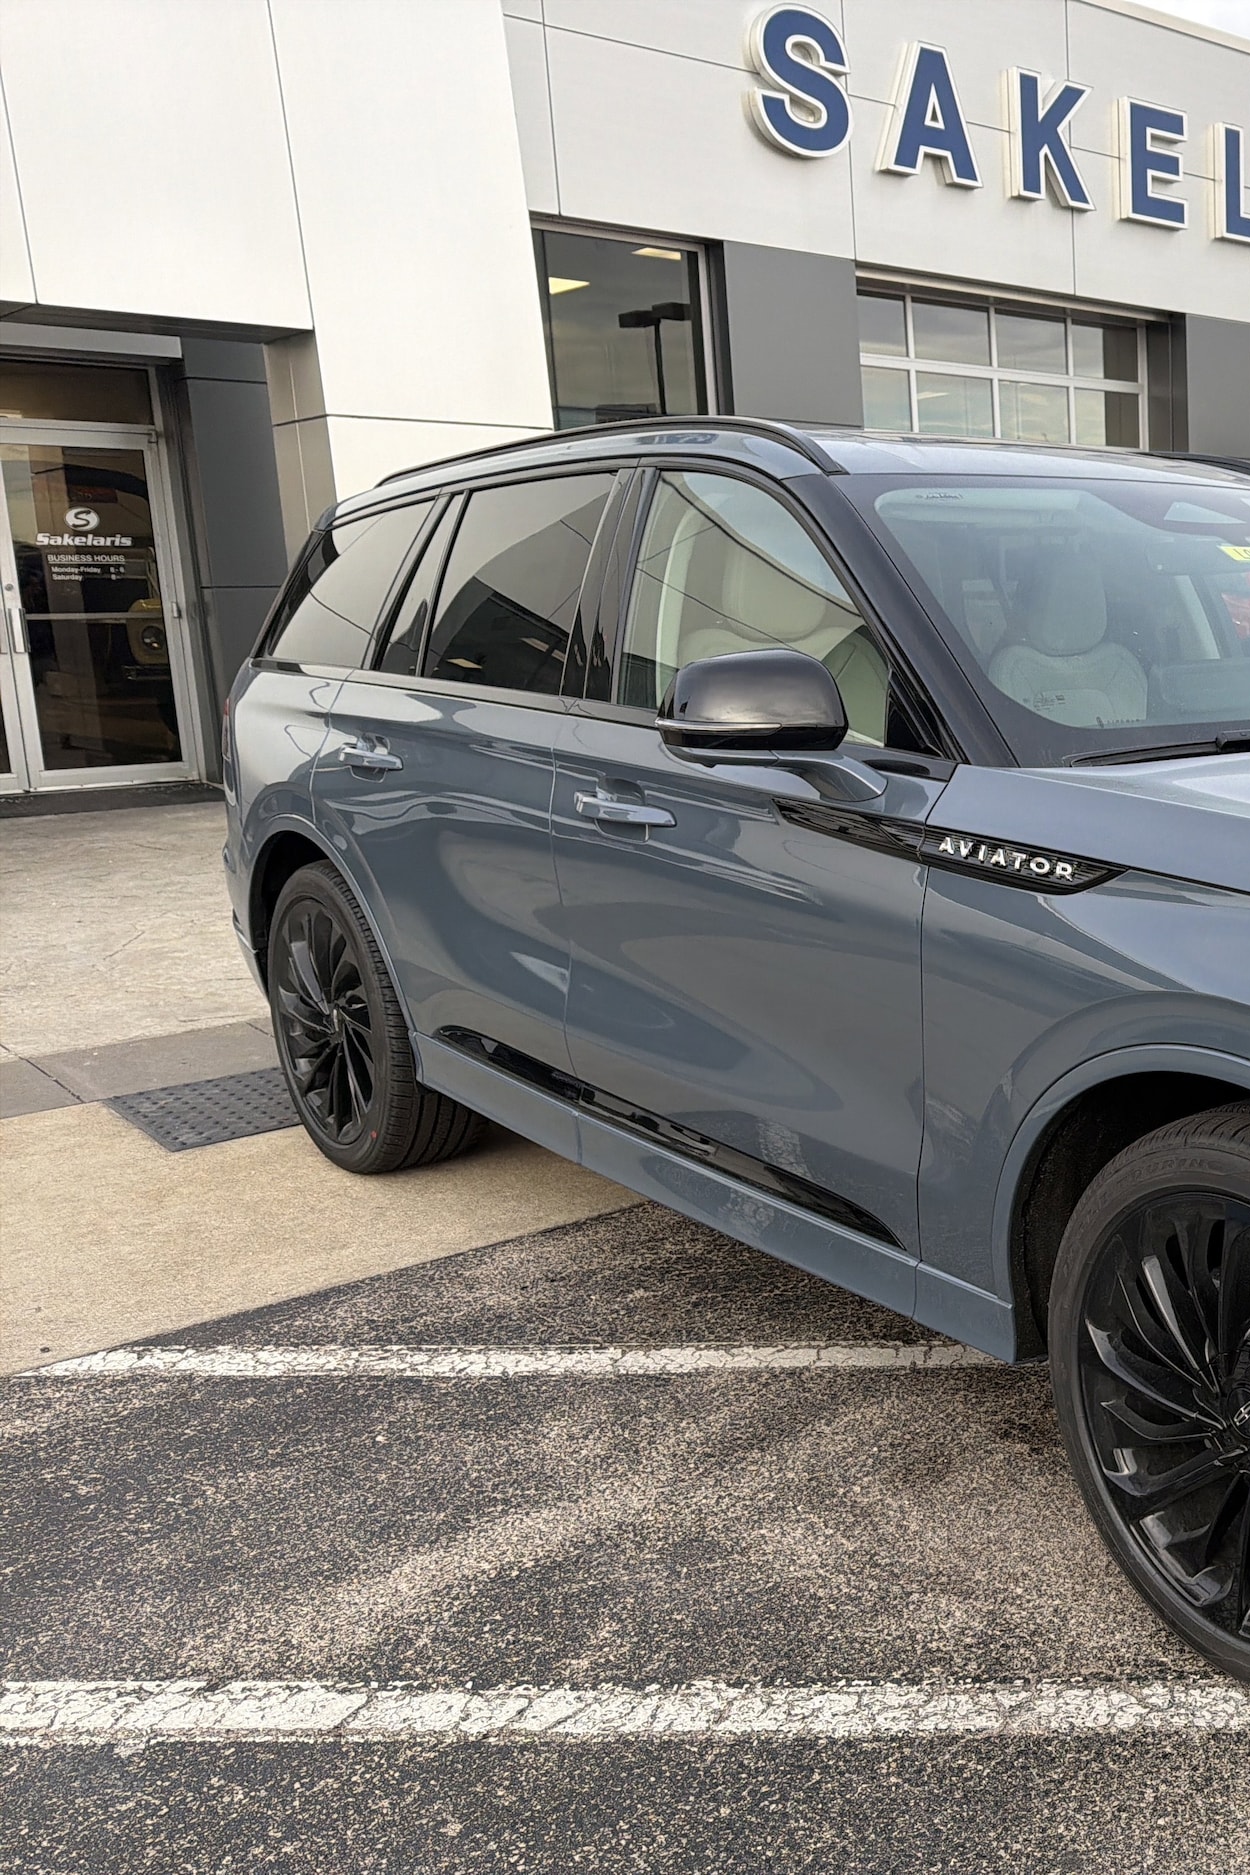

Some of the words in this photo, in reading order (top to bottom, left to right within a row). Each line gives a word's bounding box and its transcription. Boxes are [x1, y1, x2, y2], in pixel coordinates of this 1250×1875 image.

[36, 533, 133, 546] Sakelaris
[47, 554, 93, 562] BUSINESS
[94, 554, 125, 562] HOURS
[938, 836, 1074, 882] AVIATOR
